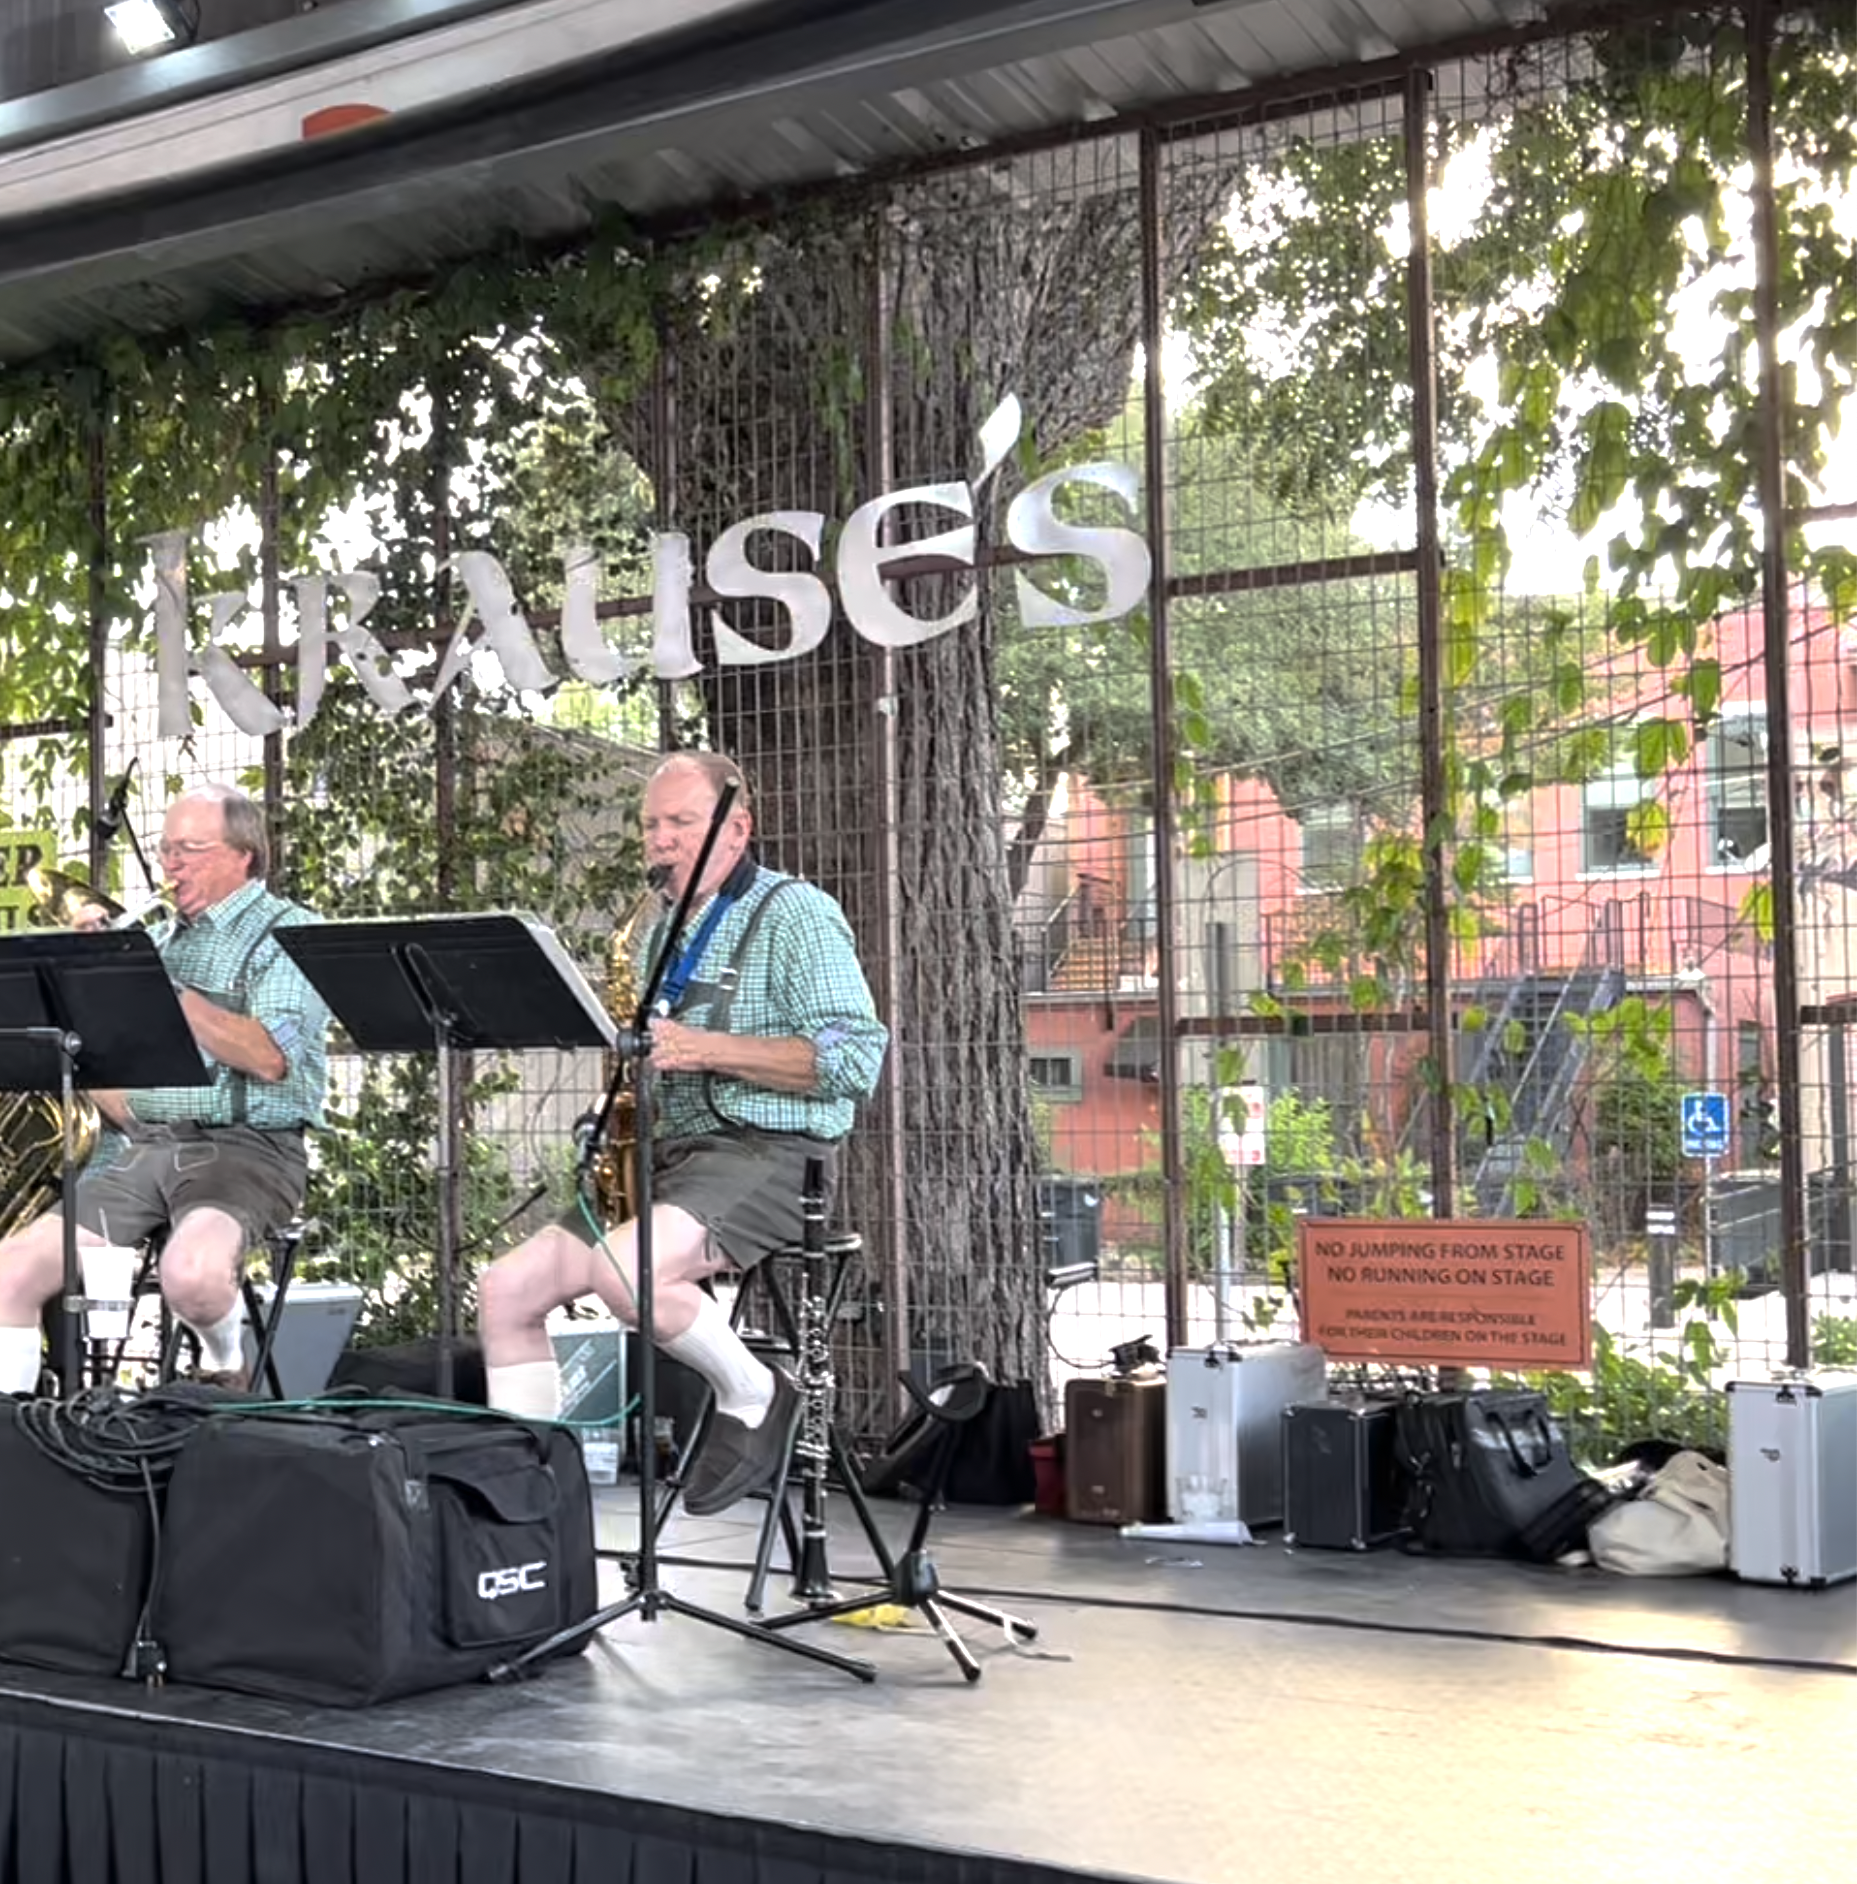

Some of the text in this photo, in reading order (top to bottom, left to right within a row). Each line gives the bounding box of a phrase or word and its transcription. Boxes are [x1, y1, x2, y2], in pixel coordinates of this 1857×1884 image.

[1315, 1242, 1565, 1260] NO JUMPING FROM STAGE
[1327, 1266, 1555, 1287] NO RUNNING ON STAGE
[1391, 1328, 1462, 1342] CHILDREN
[1465, 1330, 1487, 1342] ON
[1521, 1332, 1567, 1346] STAGE
[478, 1561, 547, 1599] QSC
